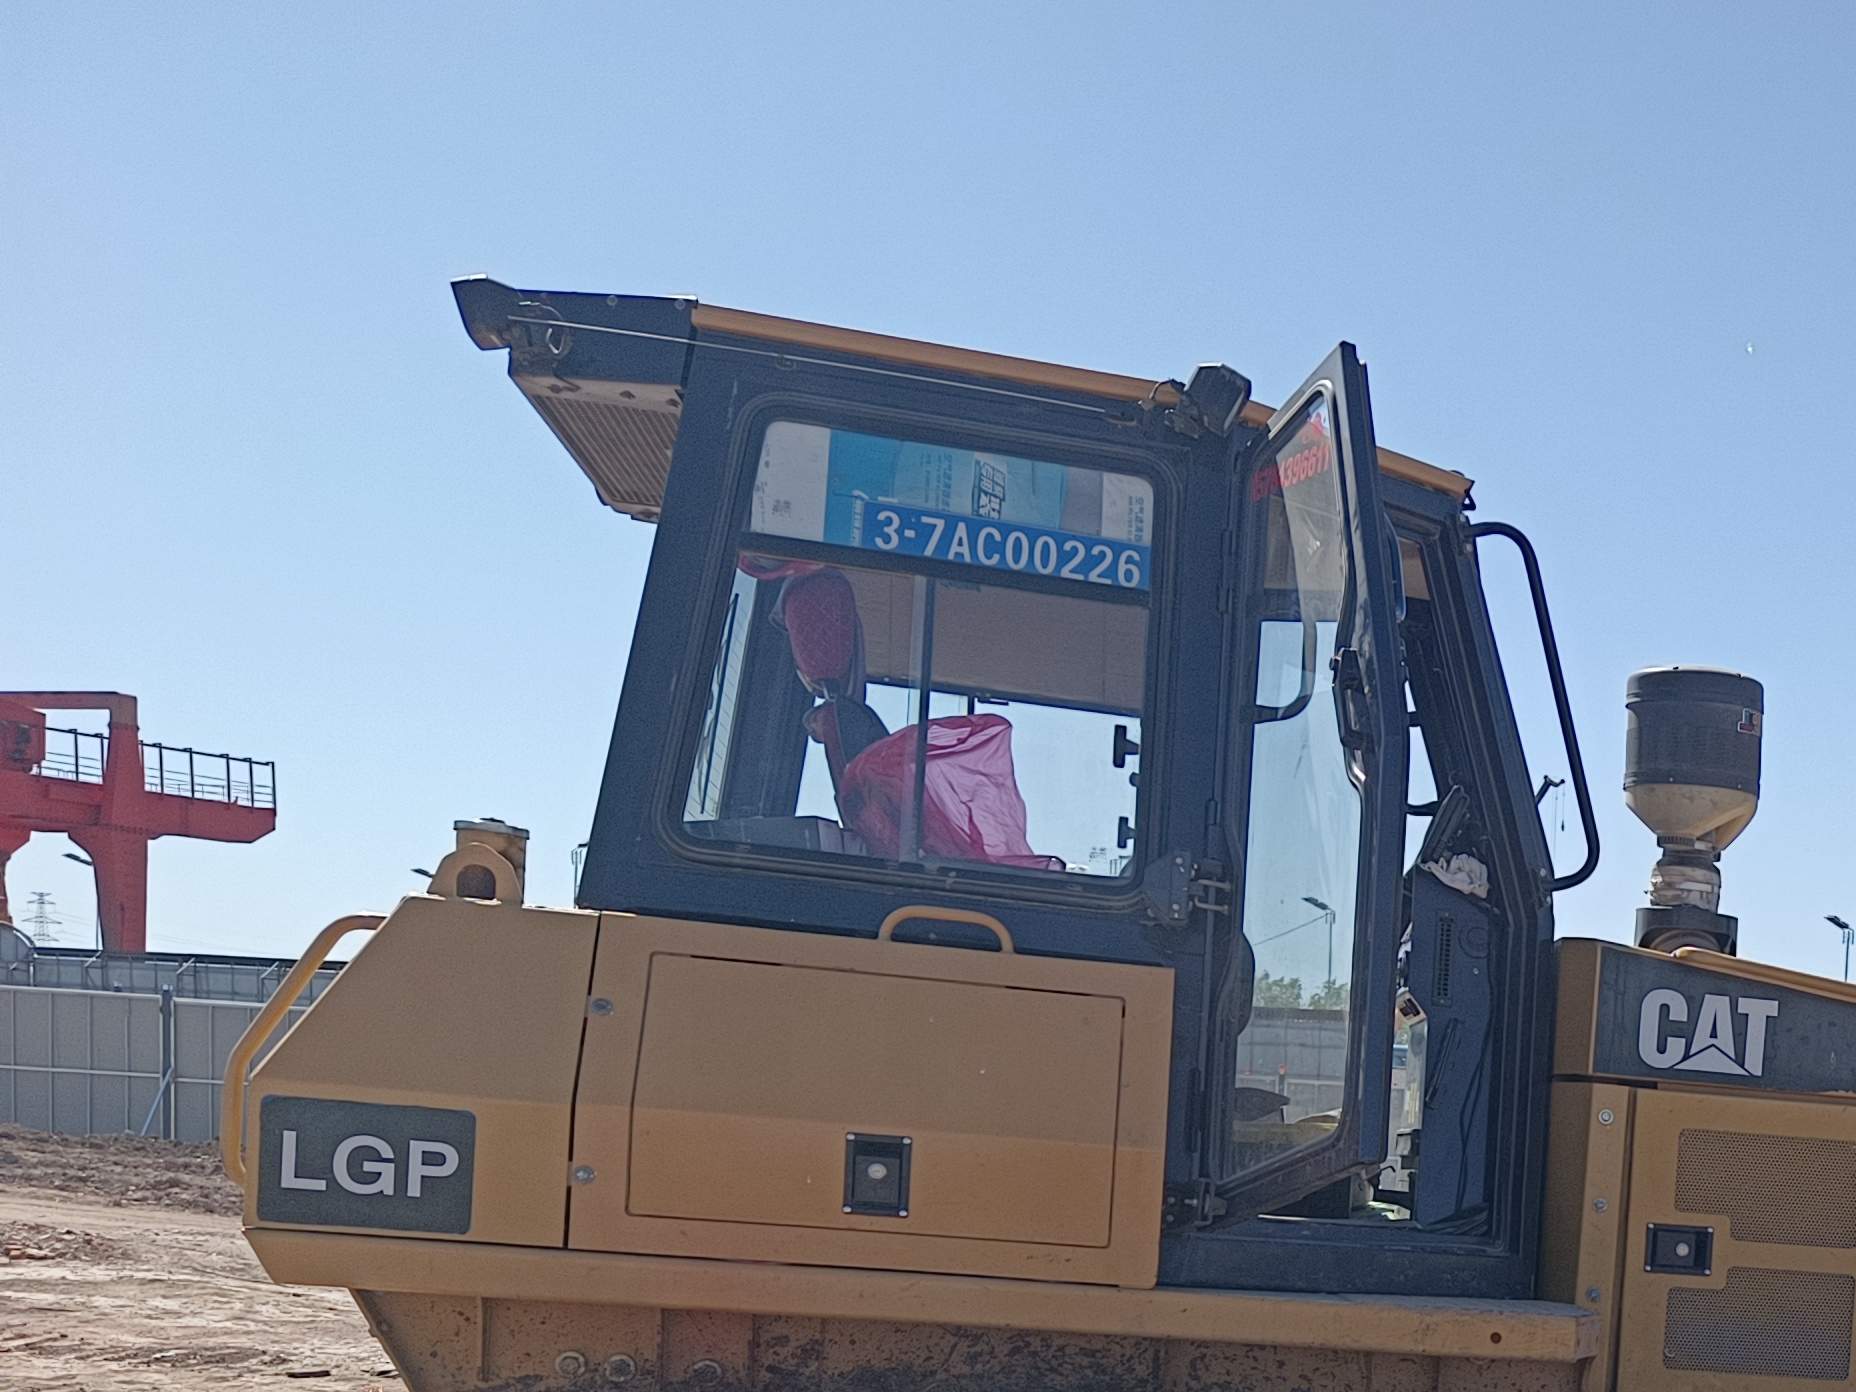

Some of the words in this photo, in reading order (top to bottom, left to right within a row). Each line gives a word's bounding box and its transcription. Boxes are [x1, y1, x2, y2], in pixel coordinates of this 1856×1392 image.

[874, 510, 1142, 588] 3-7AC00226
[1637, 987, 1779, 1077] CAT
[280, 1129, 460, 1198] LGP
